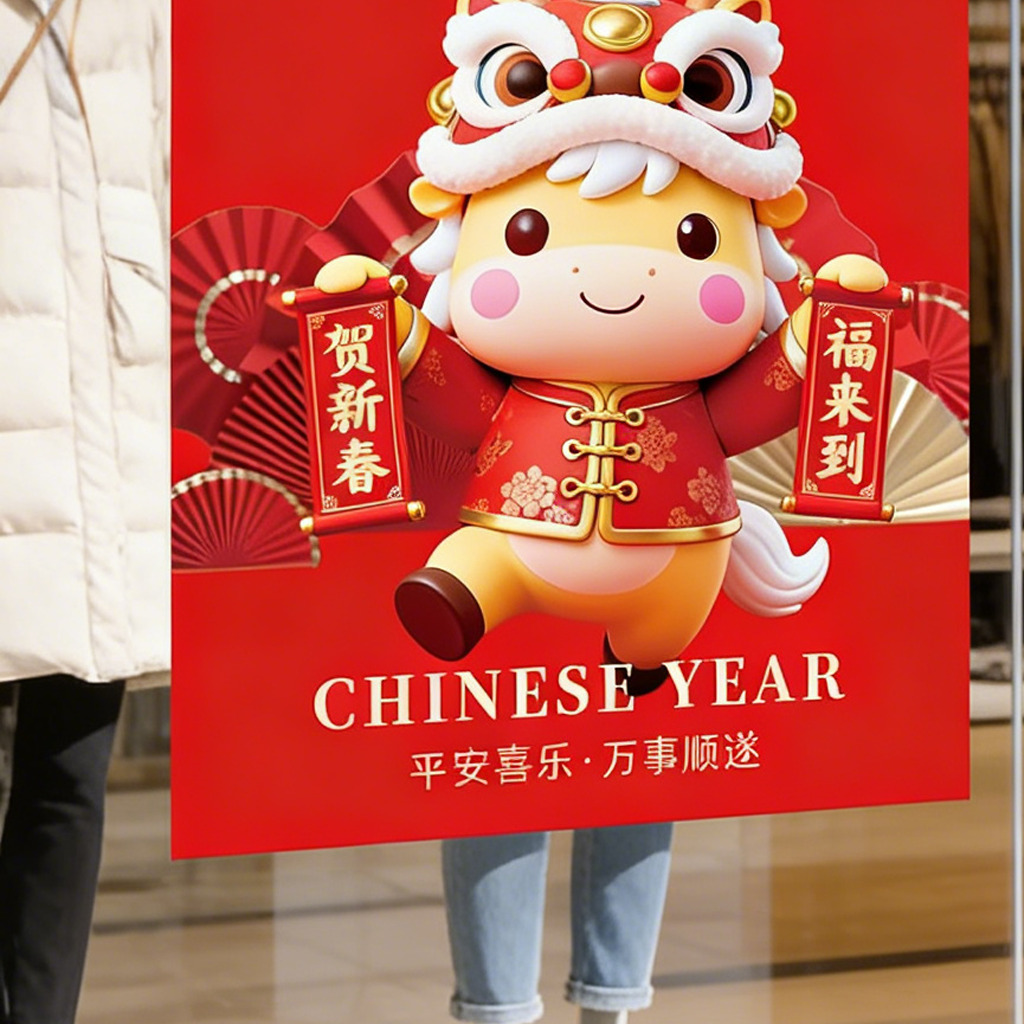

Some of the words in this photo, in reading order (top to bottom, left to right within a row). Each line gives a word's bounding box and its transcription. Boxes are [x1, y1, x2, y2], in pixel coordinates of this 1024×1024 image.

[322, 323, 391, 494] 贺新春
[815, 317, 877, 485] 福来到
[313, 662, 636, 731] CHINESE
[661, 652, 845, 709] YEAR
